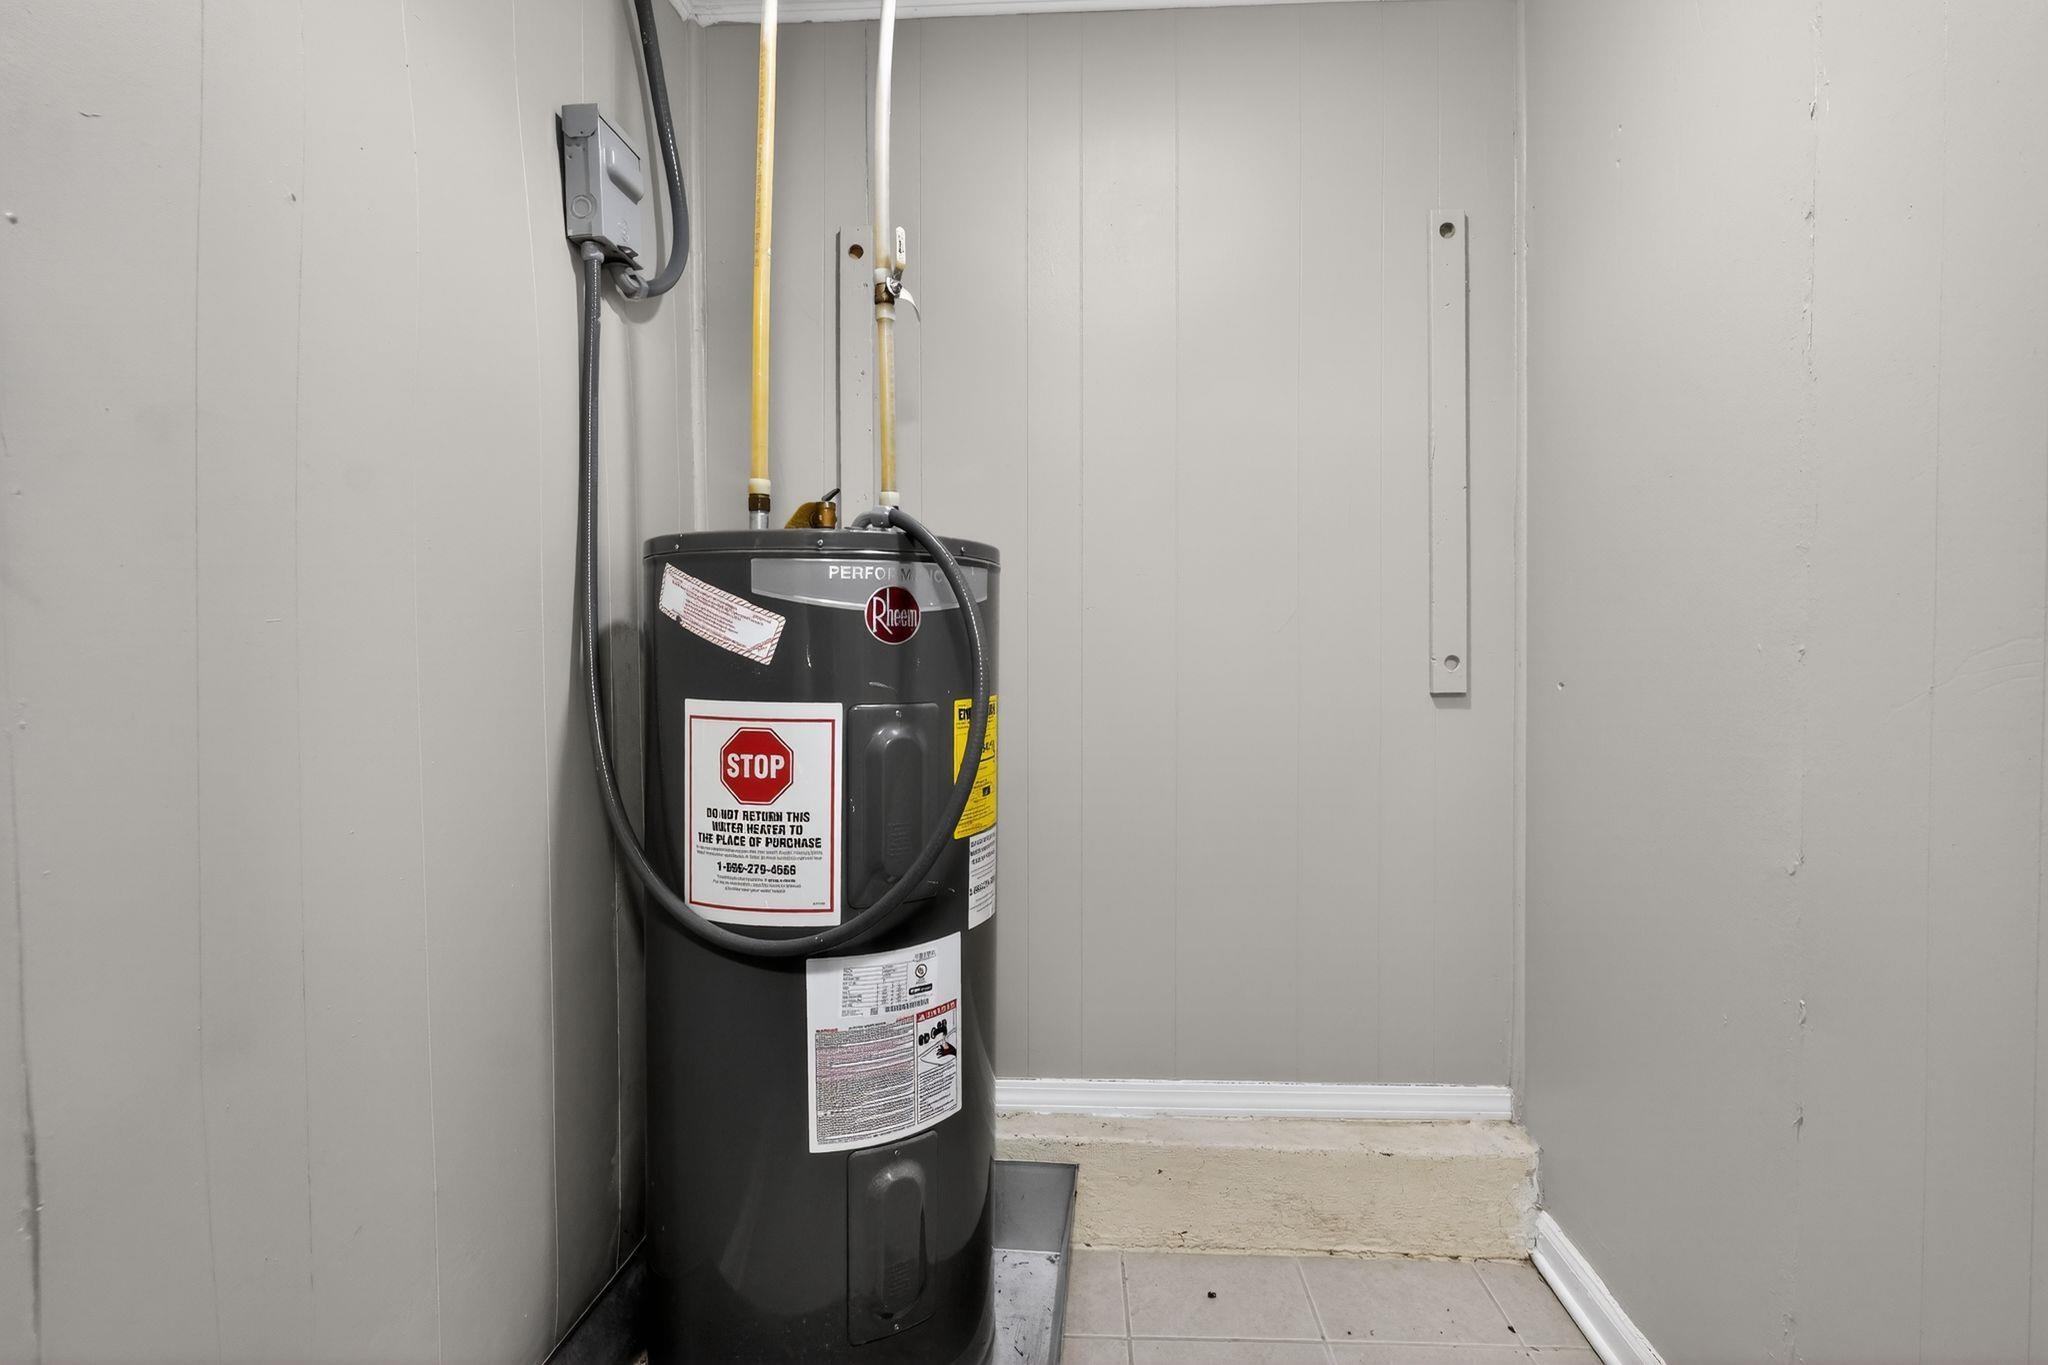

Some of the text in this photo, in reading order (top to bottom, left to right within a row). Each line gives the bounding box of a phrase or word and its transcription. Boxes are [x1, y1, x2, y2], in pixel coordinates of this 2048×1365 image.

[829, 565, 943, 582] PERFOMC
[872, 588, 918, 635] Rheem
[727, 753, 785, 779] STOP
[706, 808, 811, 823] DO NOT RETURN THIS
[712, 821, 803, 836] WATER HEATER TO
[698, 832, 822, 848] THE PLACE OF PURCHASE
